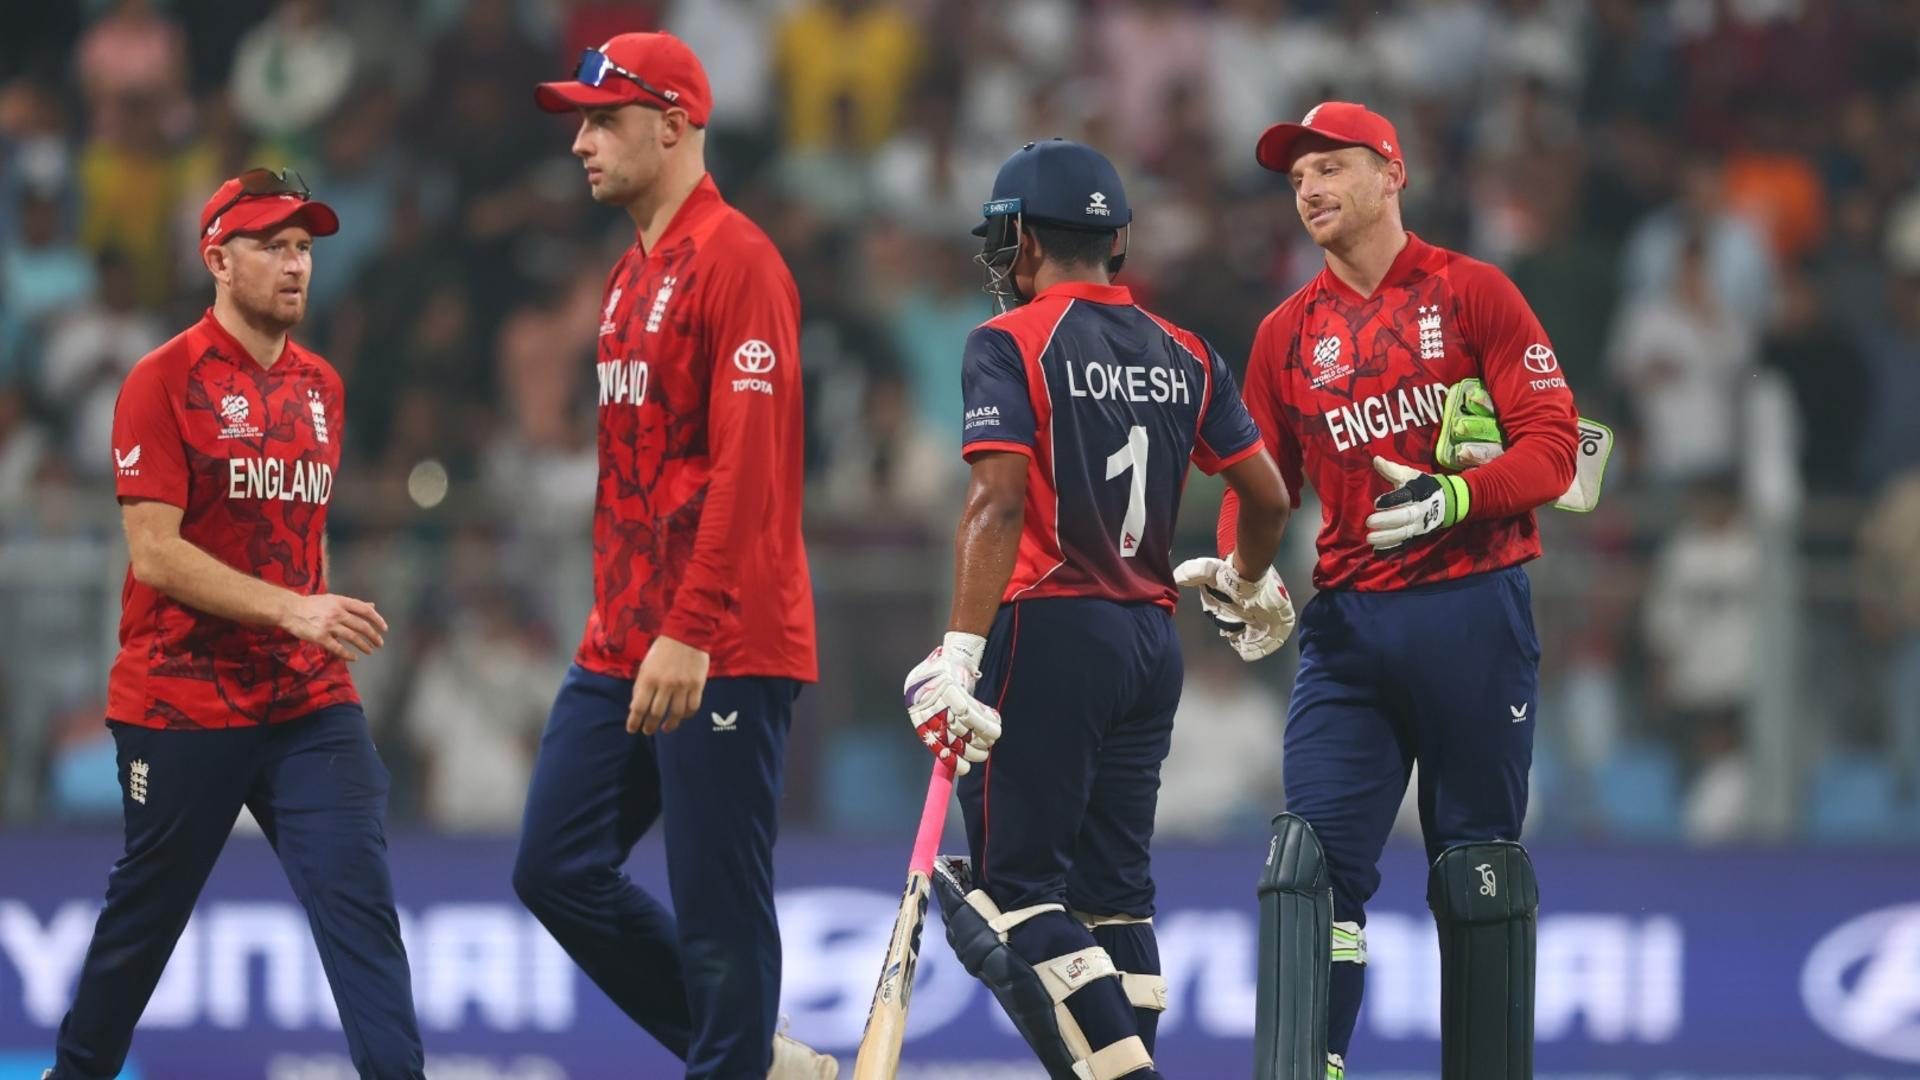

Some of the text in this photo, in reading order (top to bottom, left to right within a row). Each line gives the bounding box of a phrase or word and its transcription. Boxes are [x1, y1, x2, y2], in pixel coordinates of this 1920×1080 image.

[1085, 207, 1112, 217] SHREY
[732, 379, 773, 395] TOYOTA
[1066, 360, 1190, 404] LOKESH
[229, 456, 332, 505] ENGLAND
[1105, 426, 1149, 557] 1
